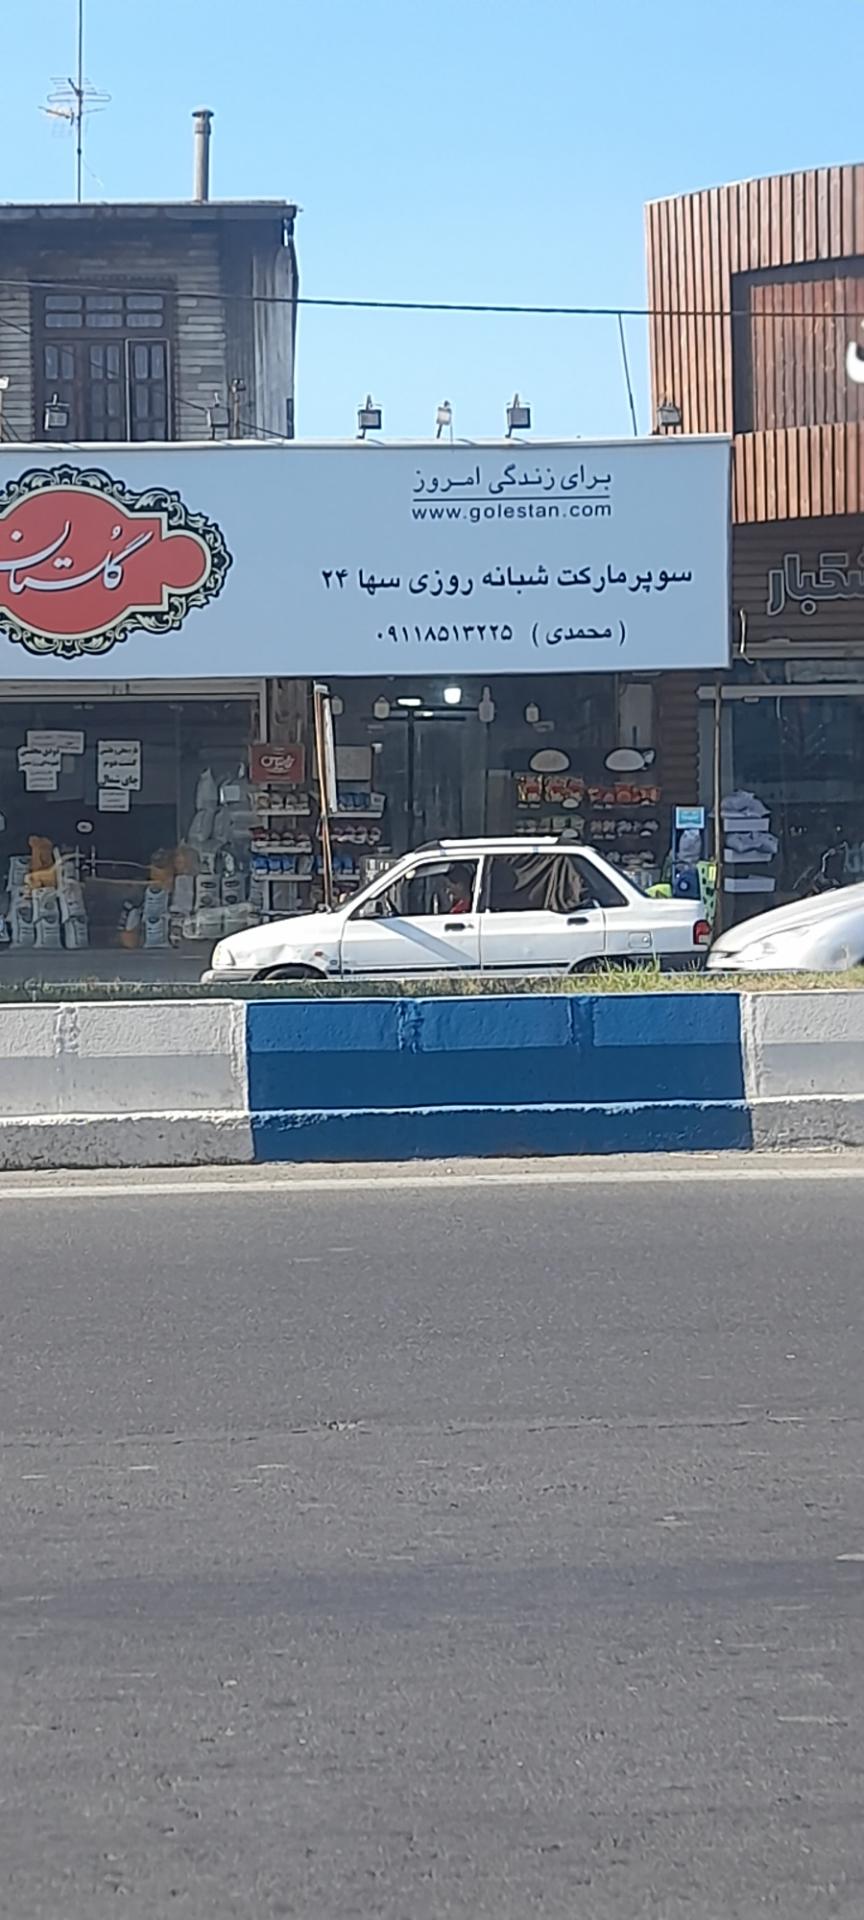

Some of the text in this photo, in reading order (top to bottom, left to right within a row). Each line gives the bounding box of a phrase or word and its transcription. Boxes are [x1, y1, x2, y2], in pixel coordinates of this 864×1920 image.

[413, 464, 612, 495] برای زندگی امروز
[412, 503, 612, 523] www.golestan.com
[321, 569, 348, 589] ۲۴
[358, 568, 401, 596] سها
[408, 568, 474, 597] روزی
[482, 564, 549, 595] شبانه
[377, 624, 513, 642] ۰۹۱۱۸۵۱۳۲۲۵
